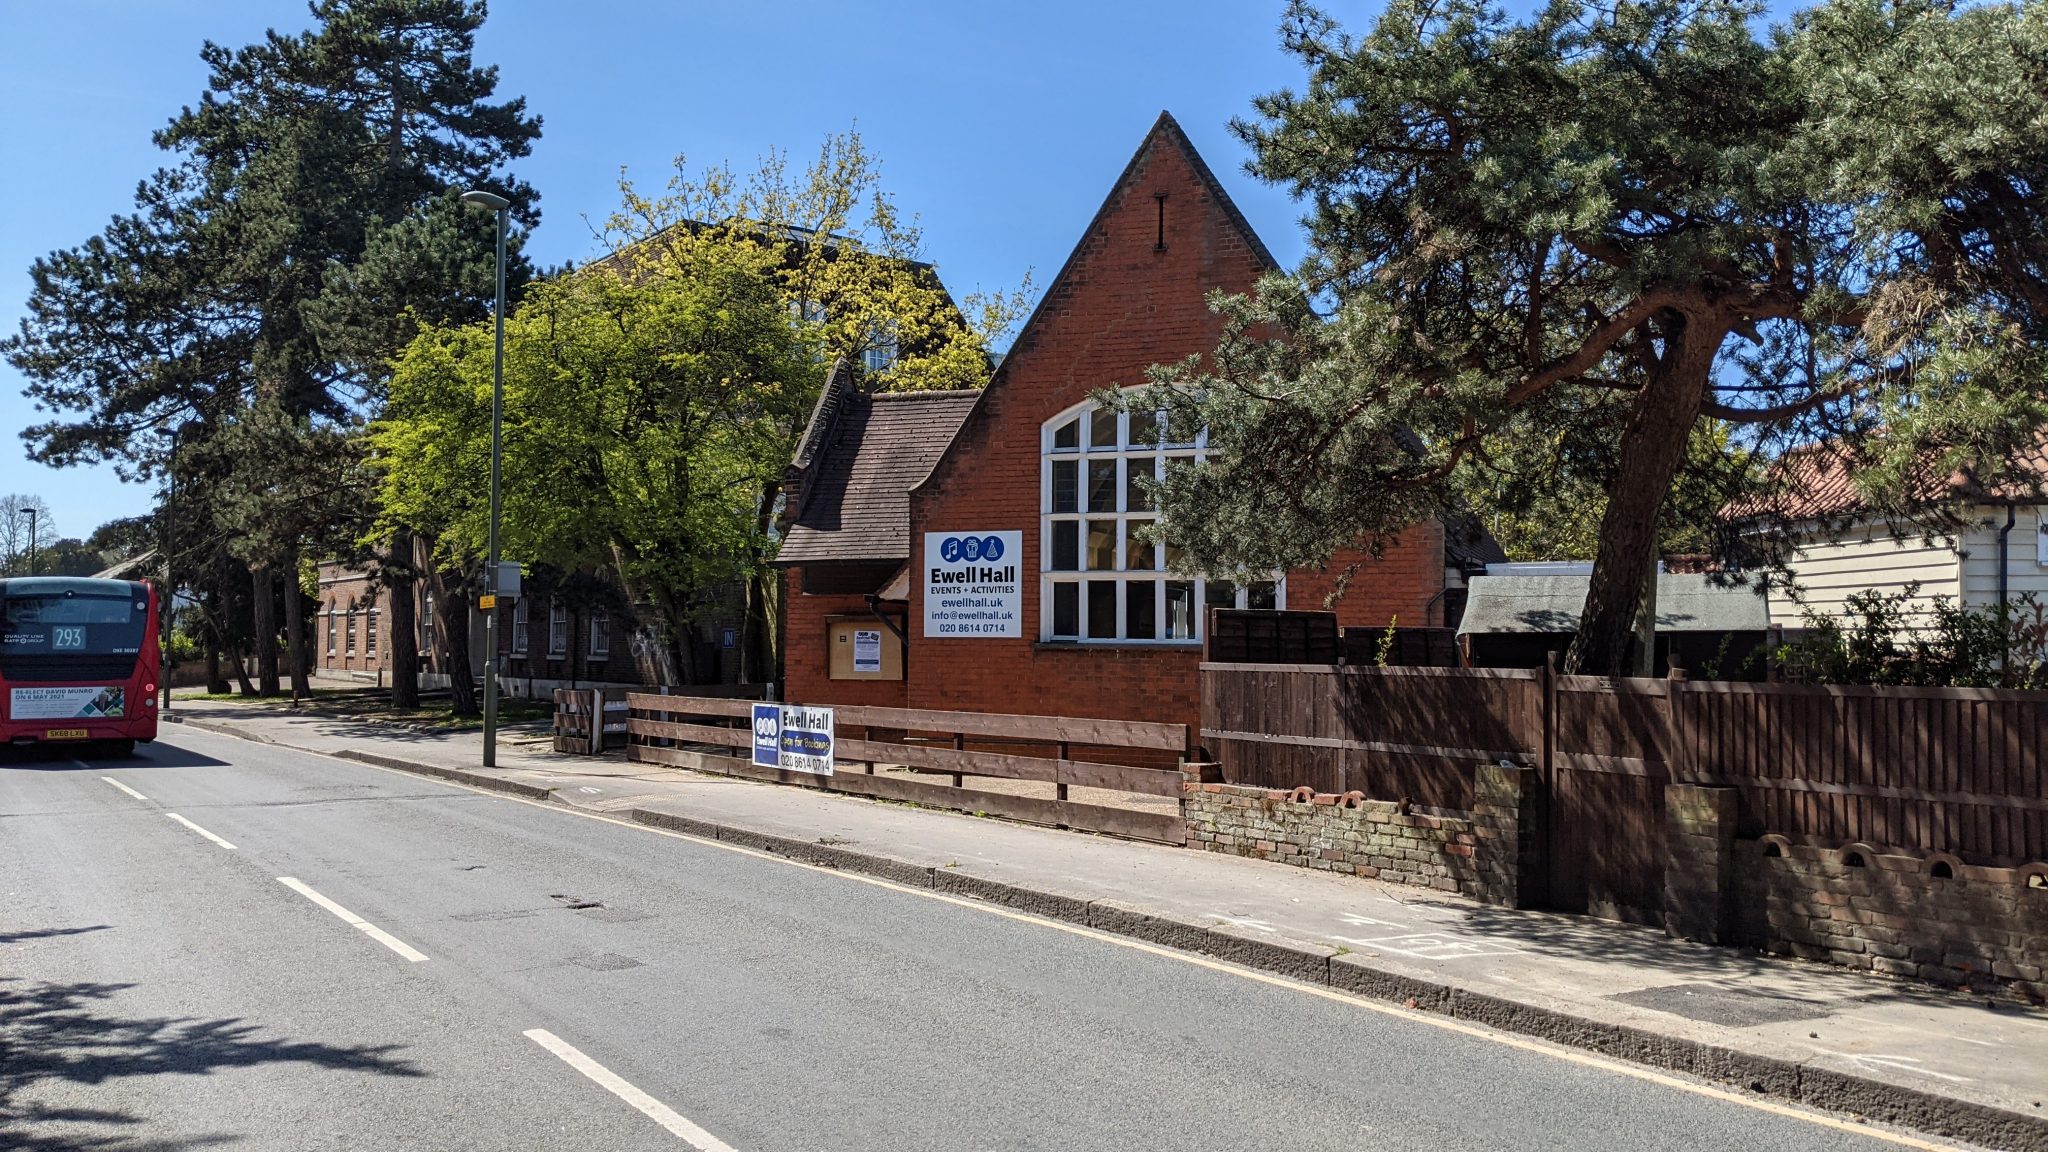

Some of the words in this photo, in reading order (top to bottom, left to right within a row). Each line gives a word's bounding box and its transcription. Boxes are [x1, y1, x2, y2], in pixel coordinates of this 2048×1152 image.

[931, 566, 976, 584] Ewell
[980, 566, 1015, 583] Hall
[930, 586, 961, 594] EVENTS
[970, 585, 1015, 594] ACTIVITIES
[941, 598, 1003, 607] ewellhall.uk
[931, 611, 1013, 620] info@ewellhall.uk
[939, 624, 956, 632] 020
[958, 623, 980, 632] 8614
[982, 623, 1005, 632] 0714
[55, 629, 81, 647] 293
[724, 631, 733, 645] IN
[783, 711, 807, 729] Ewell
[808, 713, 829, 730] Hall
[794, 735, 803, 748] for
[803, 737, 830, 754] Bookings
[780, 754, 794, 767] 020
[794, 756, 811, 769] 8614
[812, 758, 830, 772] 0714
